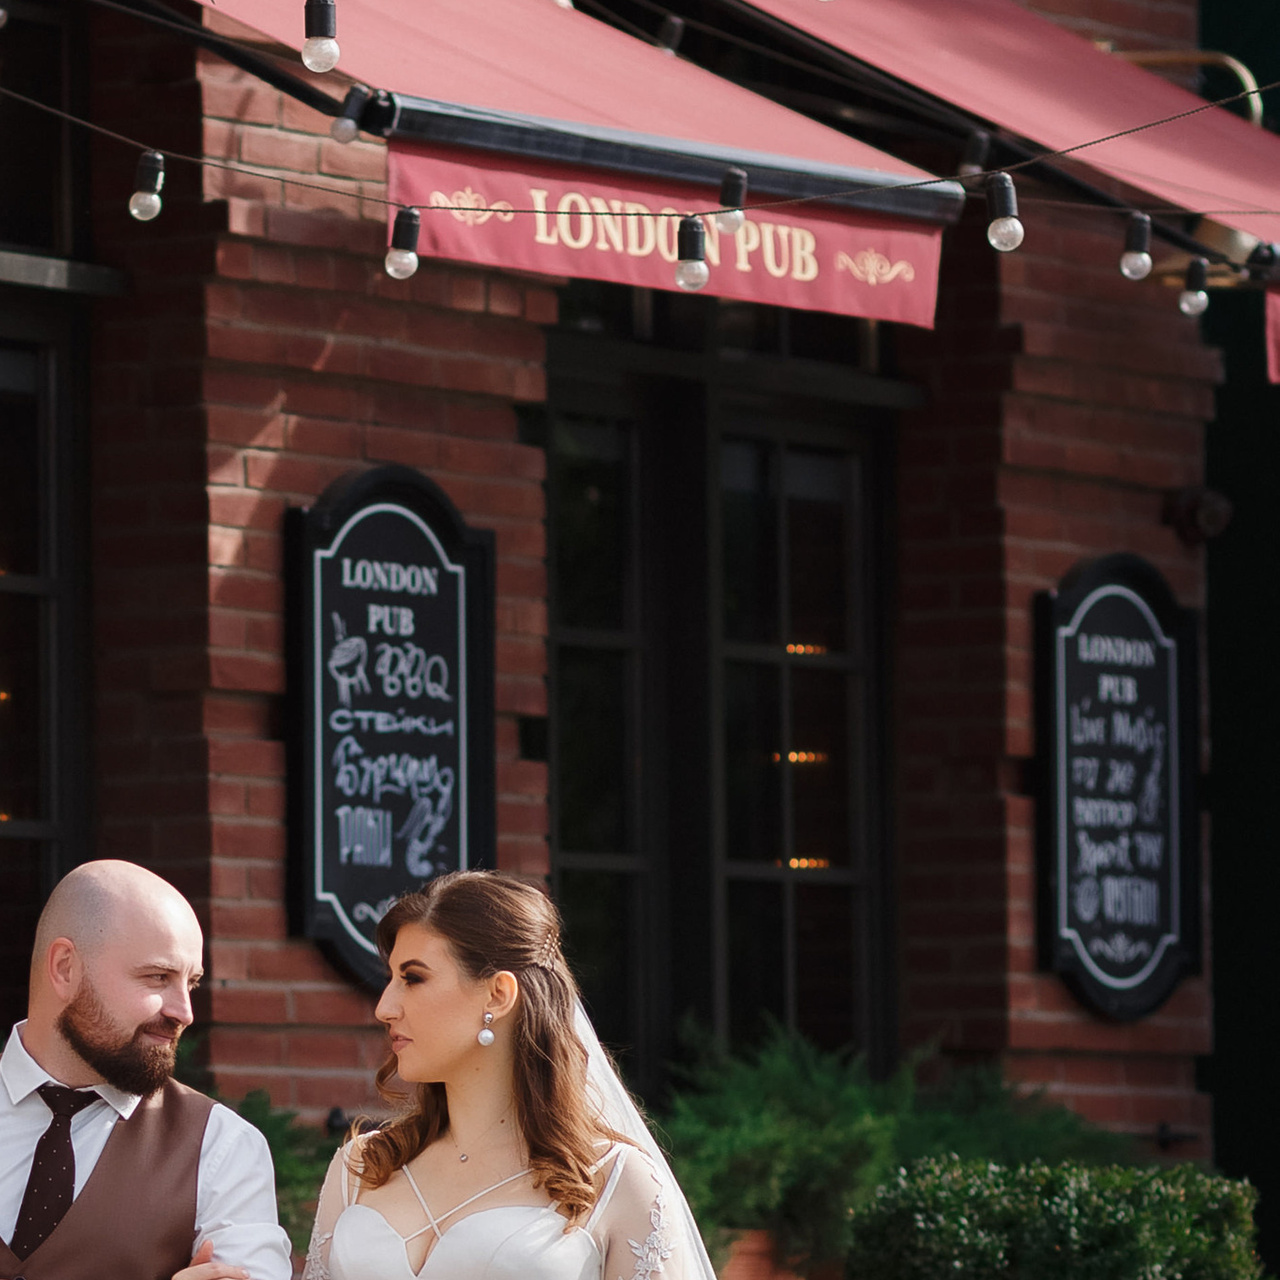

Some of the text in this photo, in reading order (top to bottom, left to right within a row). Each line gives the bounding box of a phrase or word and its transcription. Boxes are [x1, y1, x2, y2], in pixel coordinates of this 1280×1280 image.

[733, 218, 820, 282] PUB
[341, 557, 439, 596] LONDON
[367, 602, 415, 637] PUB
[1098, 673, 1138, 706] PUB
